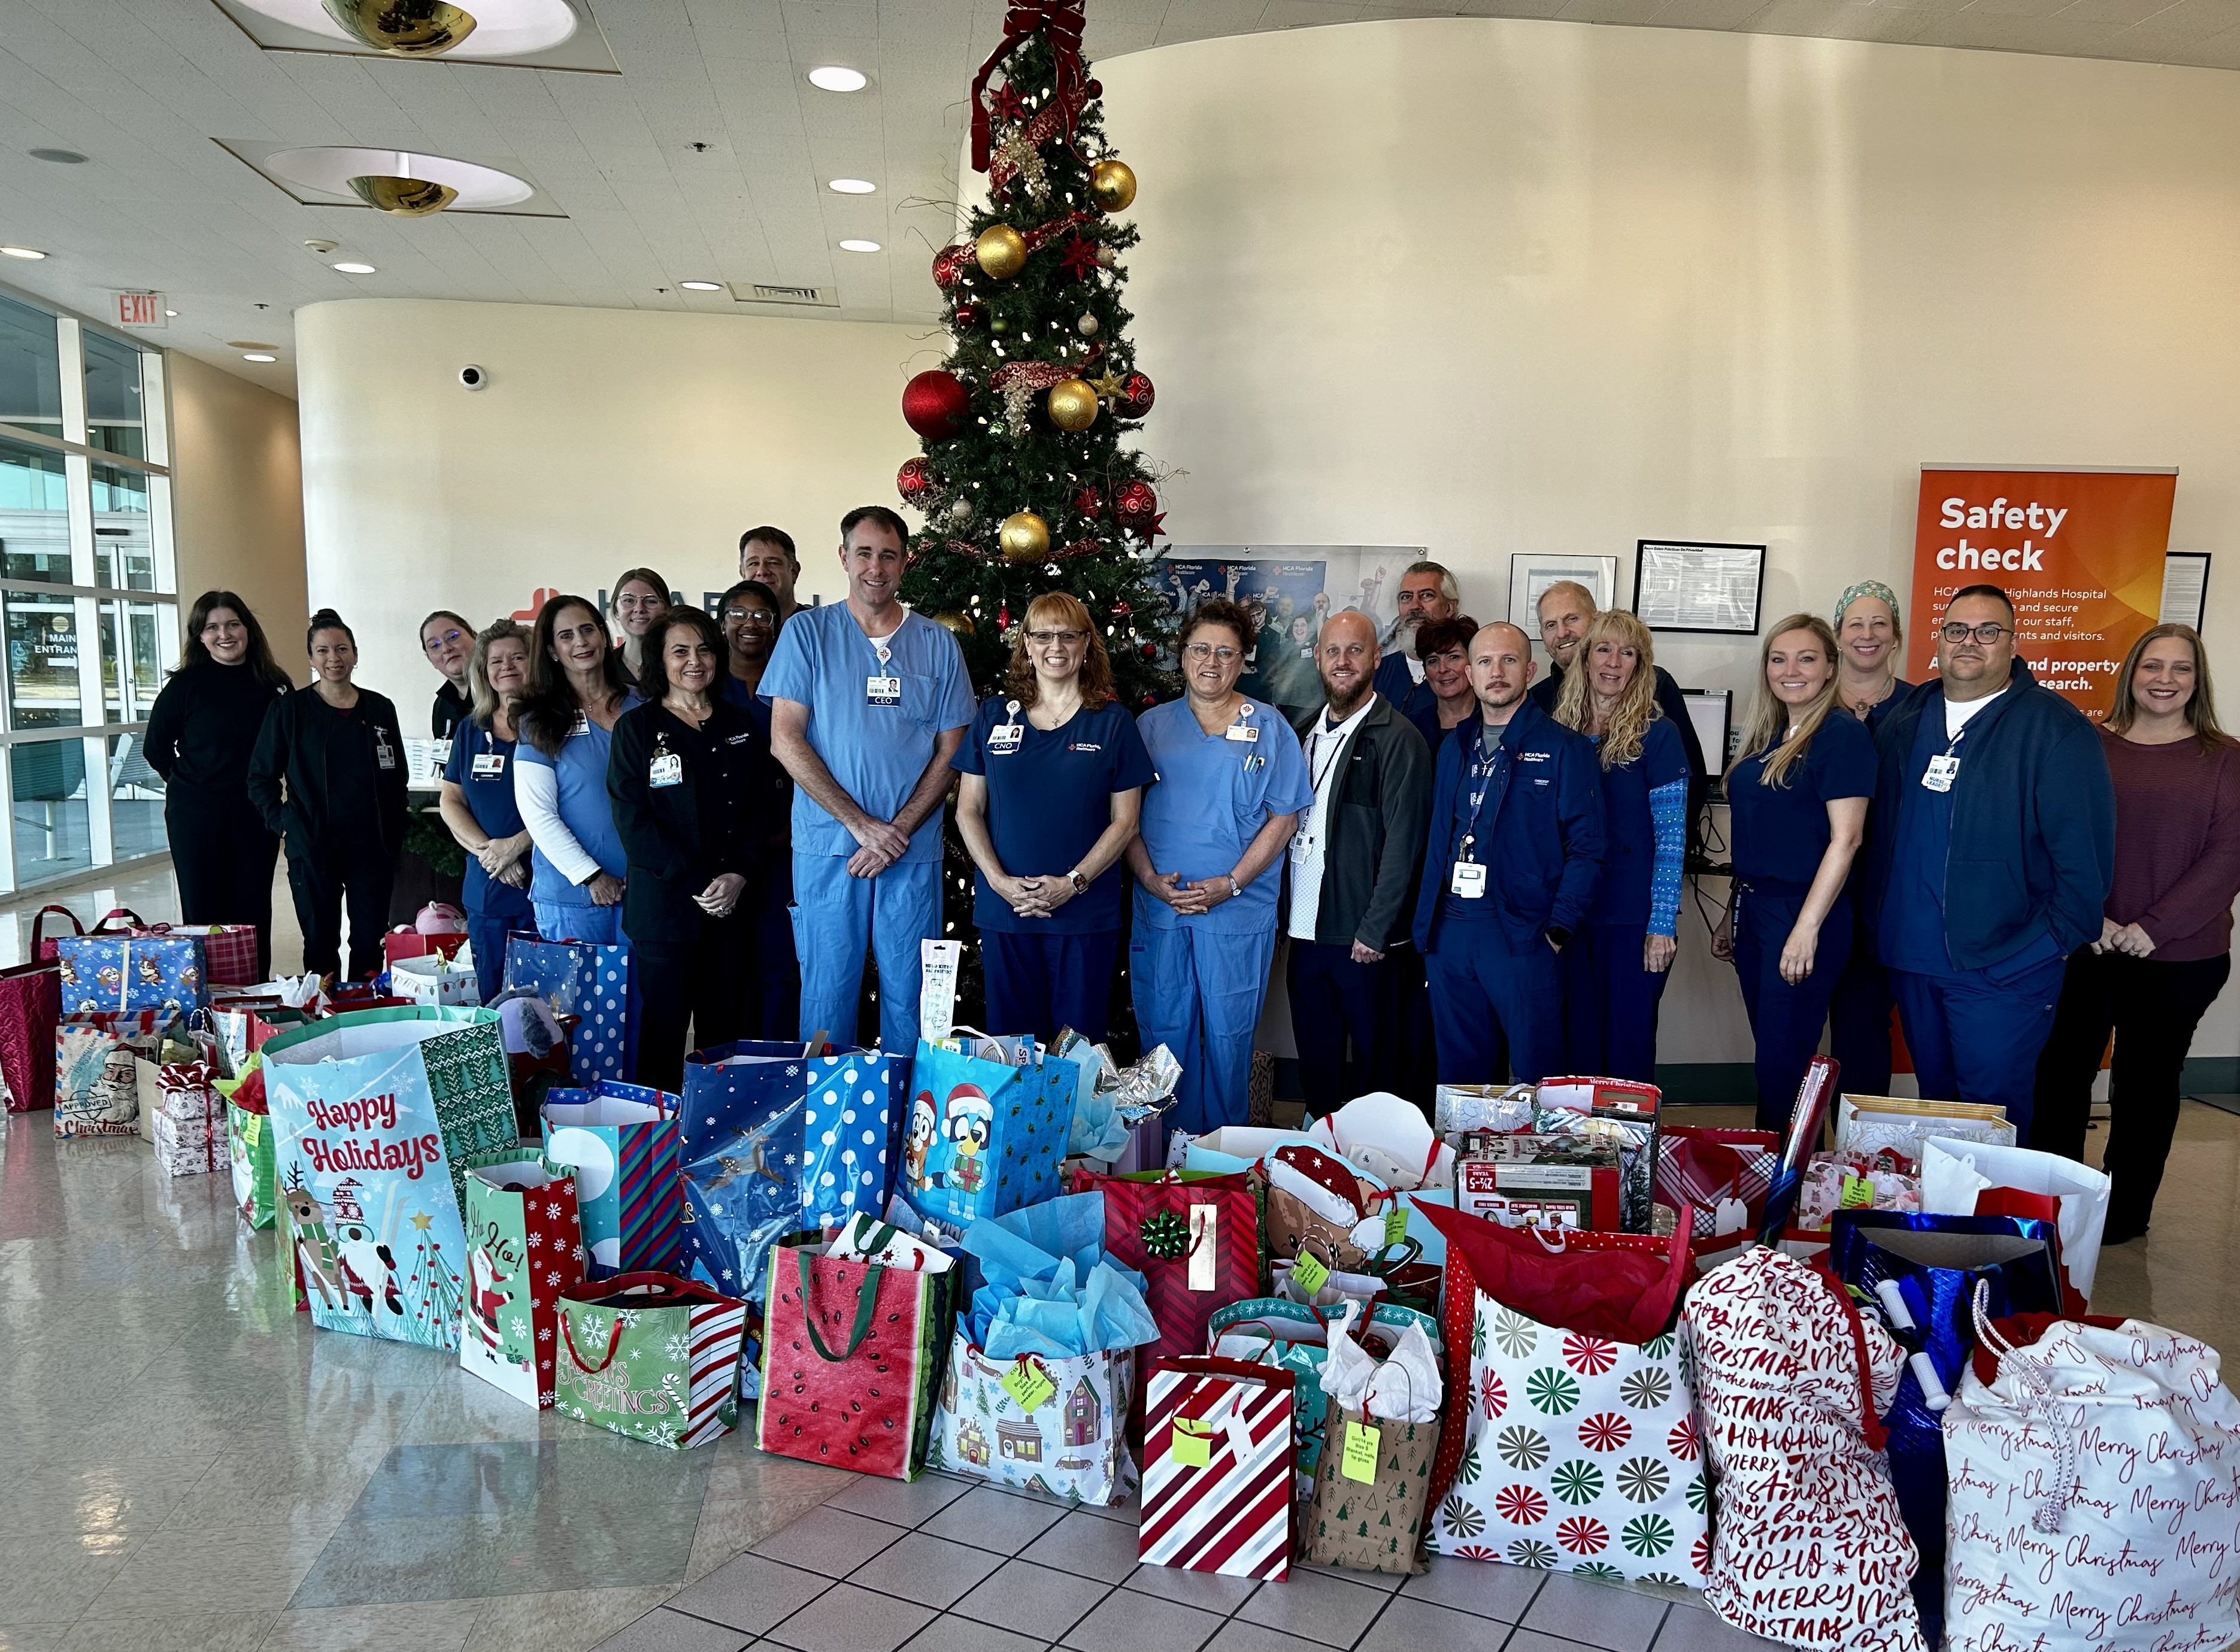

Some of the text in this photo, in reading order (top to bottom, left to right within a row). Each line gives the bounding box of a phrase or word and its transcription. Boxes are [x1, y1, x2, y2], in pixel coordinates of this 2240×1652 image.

[120, 295, 157, 323] EXIT
[1939, 498, 2068, 538] Safety
[1936, 539, 2045, 571] check
[1933, 587, 2107, 601] HCA Highlands Hospital
[2019, 602, 2040, 612] and
[2043, 604, 2078, 613] secure
[49, 634, 76, 642] MAIN
[2040, 631, 2060, 640] and
[2063, 631, 2105, 641] visitors.
[2045, 617, 2074, 628] staff,
[35, 645, 77, 653] ENTRAN
[2027, 657, 2120, 675] nd property
[2038, 677, 2093, 690] search.
[1610, 1081, 1647, 1090] Christmas
[63, 1099, 108, 1110] APPROVED
[307, 1093, 397, 1132] Happy
[302, 1133, 441, 1180] Holidays
[471, 1201, 484, 1239] Ho
[485, 1221, 524, 1272] Ho!
[1697, 1331, 1807, 1381] CHRISTMAS
[2131, 1333, 2206, 1368] Christmas
[572, 1377, 670, 1415] GREETINGS
[1020, 1381, 1028, 1389] Size
[1699, 1381, 1794, 1423] CHRISTMAS
[1728, 1422, 1829, 1454] HOHOHO
[1724, 1453, 1780, 1472] MERRY
[2078, 1426, 2142, 1484] Merry
[2147, 1428, 2224, 1466] Christmas
[2130, 1466, 2240, 1535] Merry Christ
[2006, 1524, 2165, 1585] Merry Christmas
[2175, 1530, 2230, 1579] Merry
[1753, 1584, 1854, 1612] MERRY
[1721, 1599, 1854, 1642] CHRISTMAS
[2050, 1589, 2202, 1641] Merry Christmas
